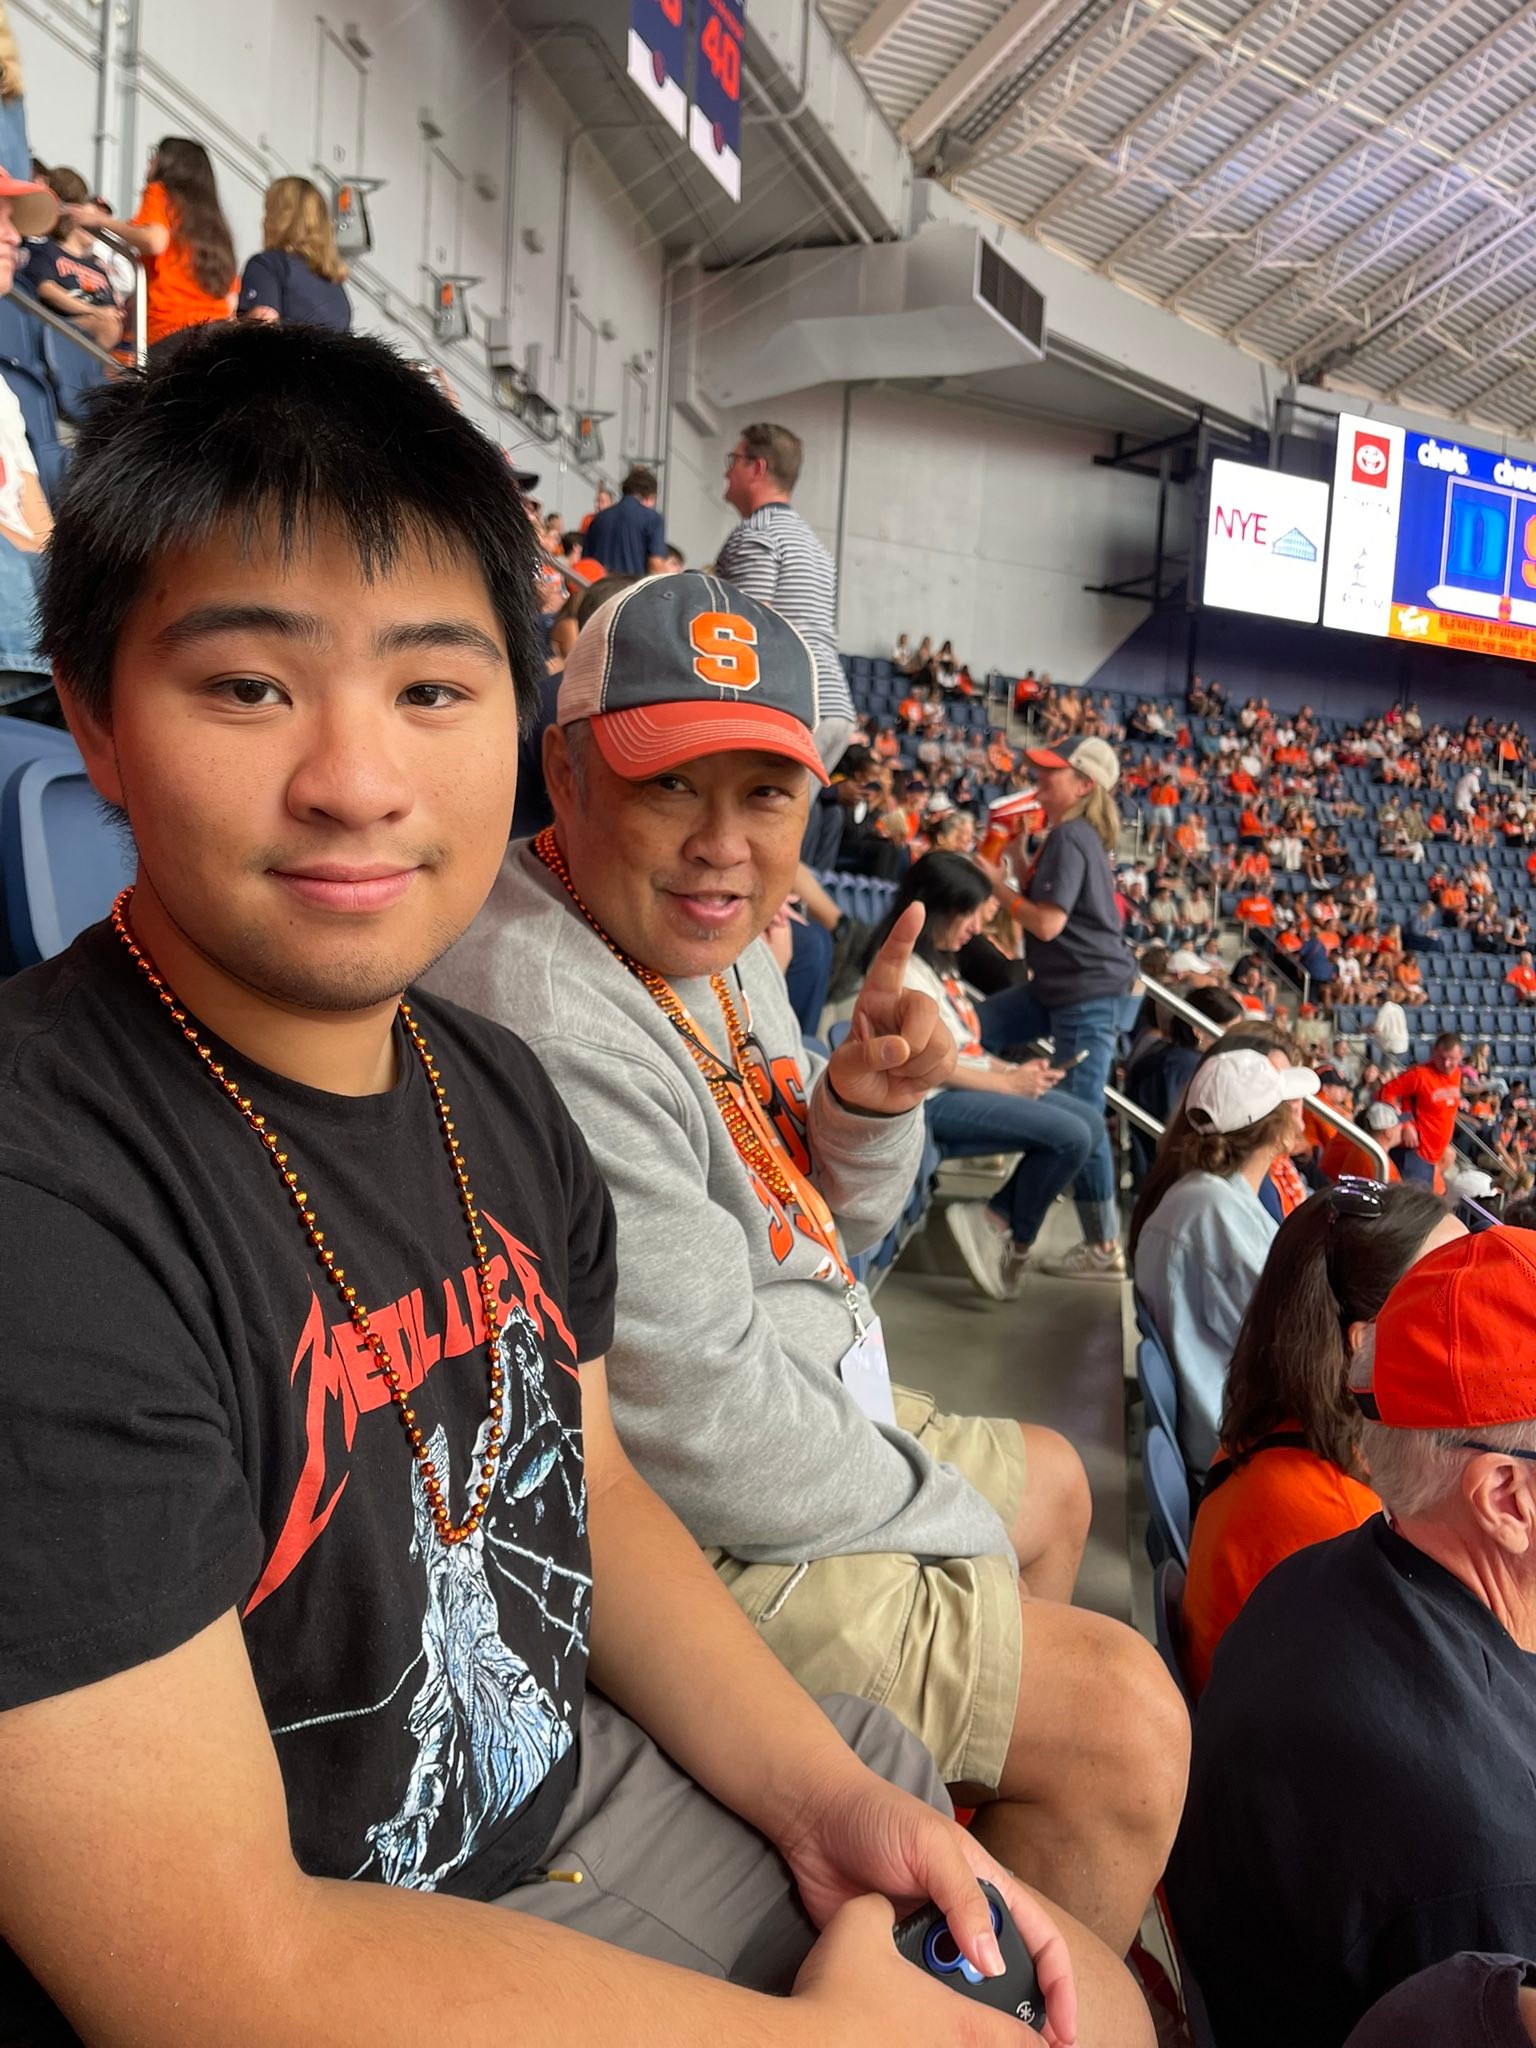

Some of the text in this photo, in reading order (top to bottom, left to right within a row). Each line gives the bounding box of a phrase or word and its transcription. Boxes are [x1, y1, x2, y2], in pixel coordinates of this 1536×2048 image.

[701, 15, 740, 101] 40
[1214, 505, 1268, 545] NYE
[689, 611, 760, 691] S
